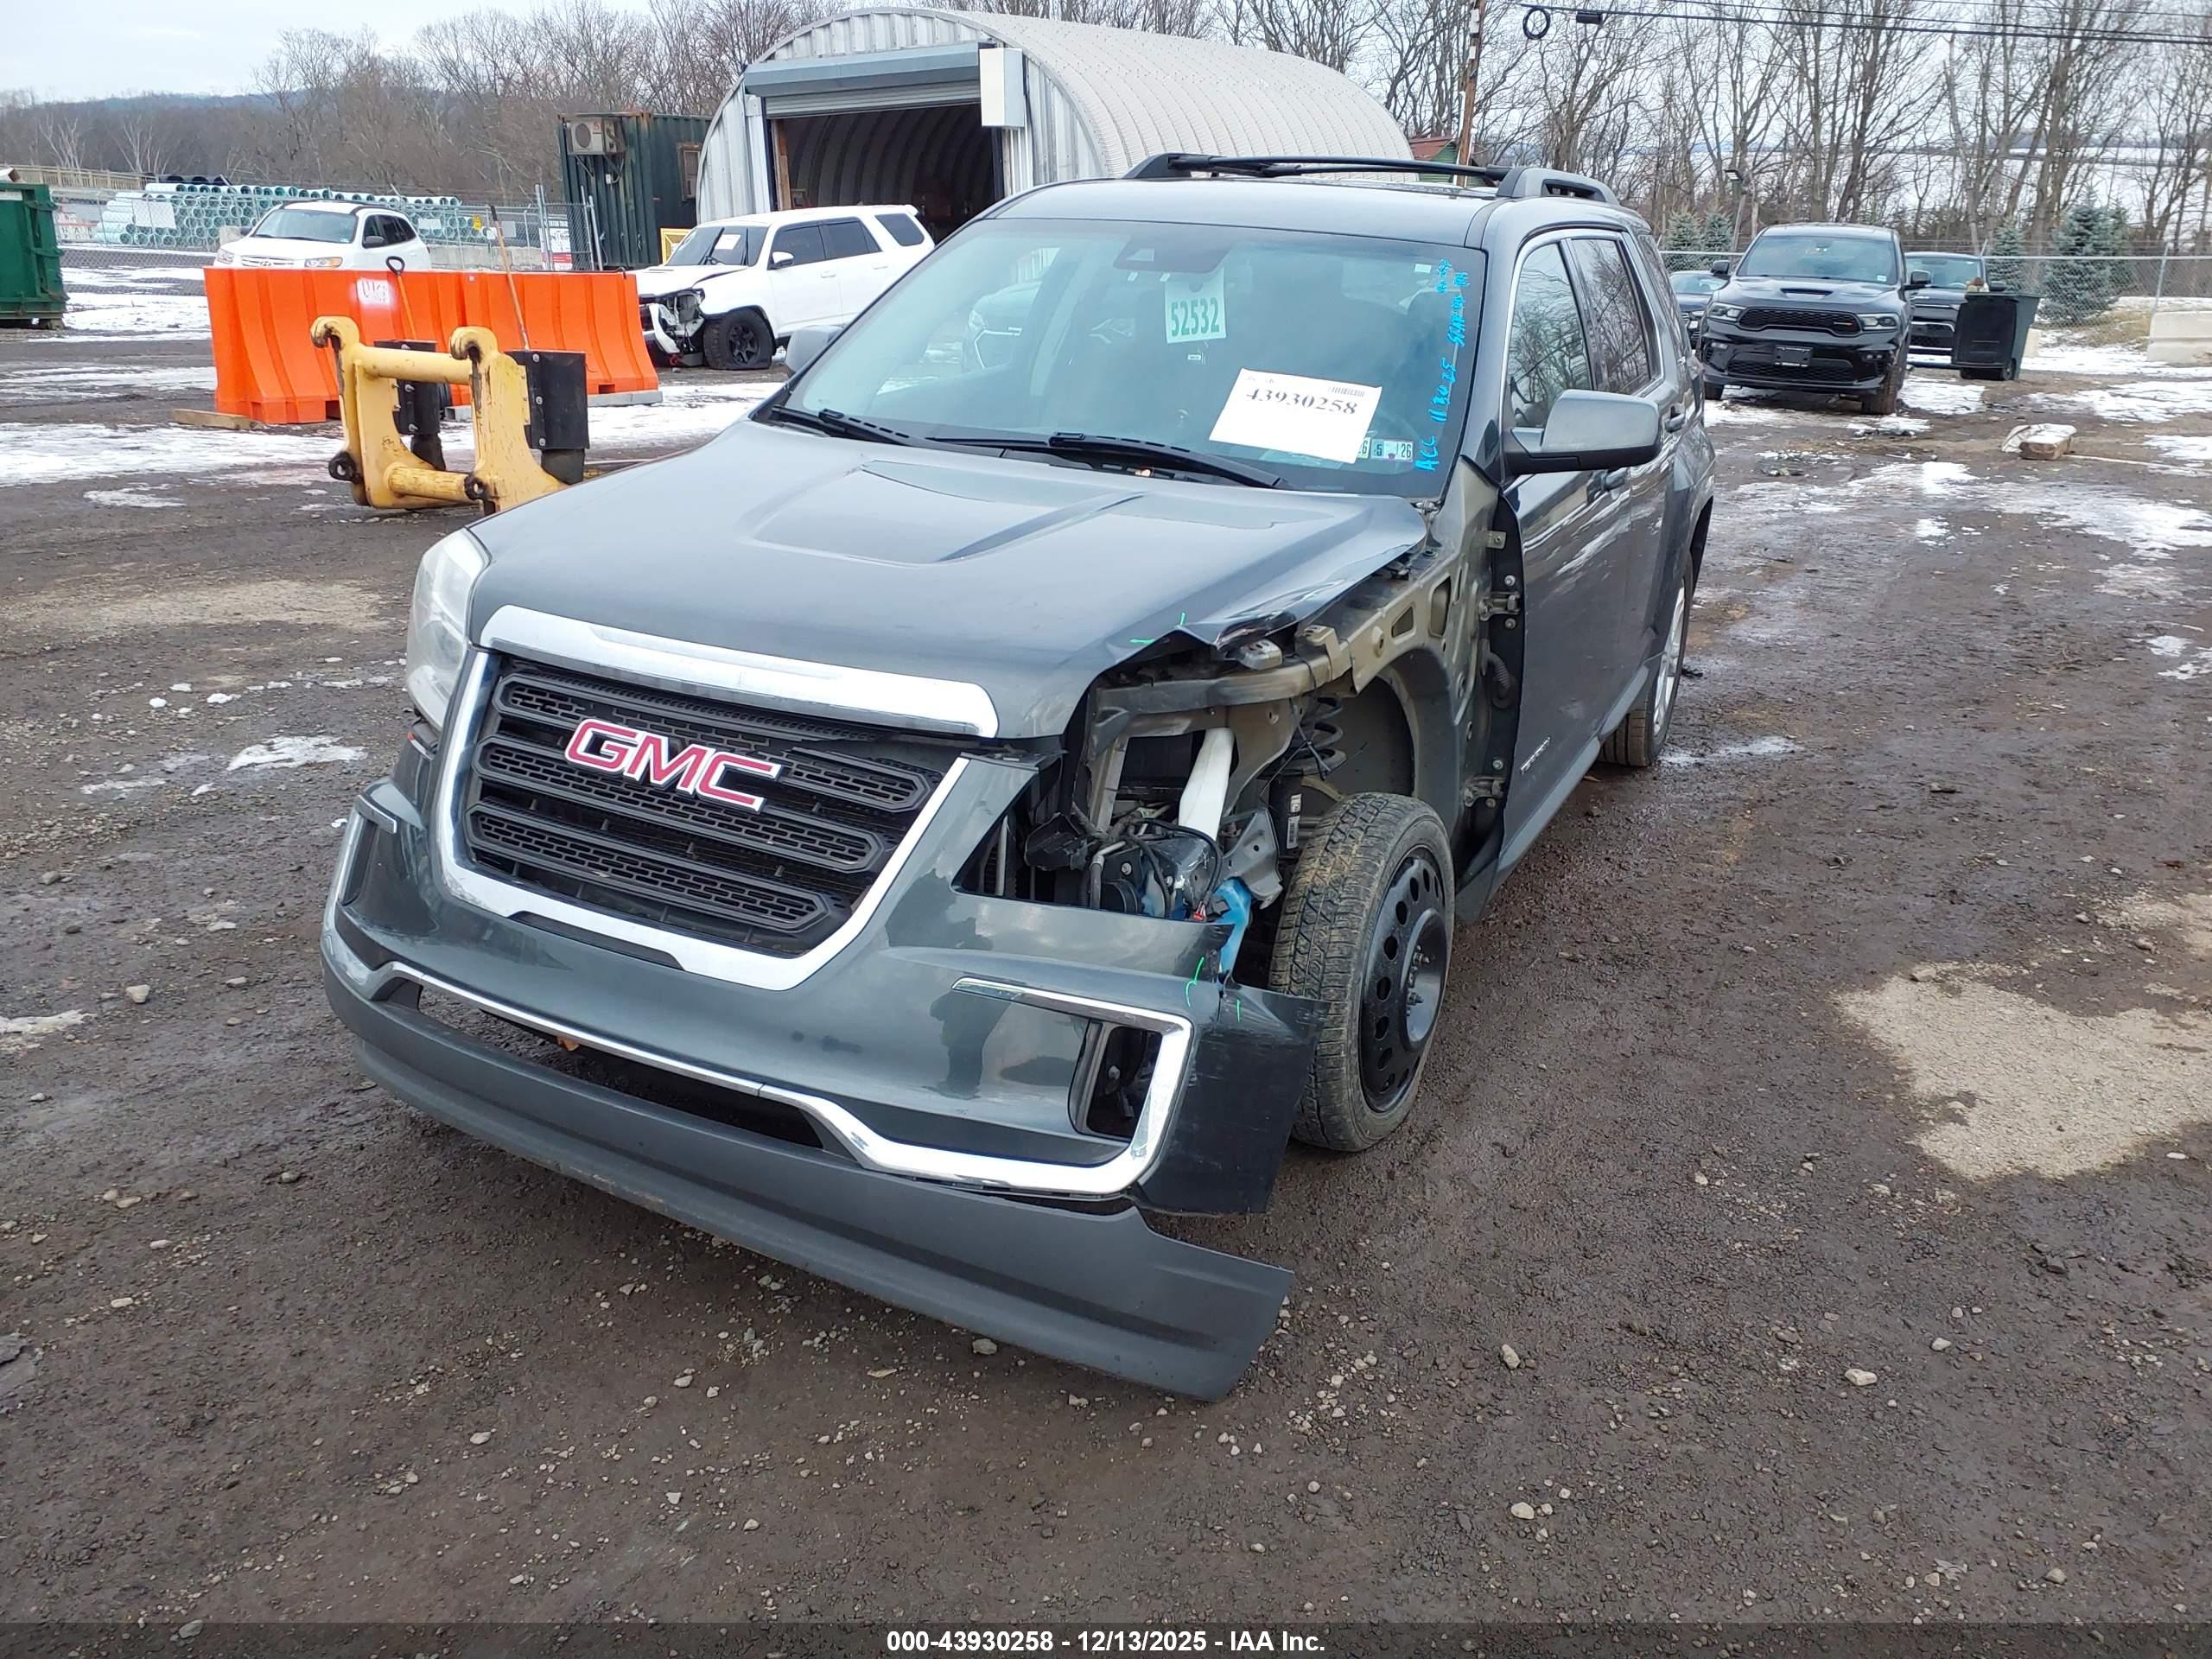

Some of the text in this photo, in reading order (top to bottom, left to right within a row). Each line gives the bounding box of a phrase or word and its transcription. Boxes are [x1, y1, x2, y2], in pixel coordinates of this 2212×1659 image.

[1171, 296, 1220, 337] 52532
[1246, 388, 1357, 415] 43930258
[1401, 442, 1412, 458] 26
[564, 718, 782, 811] GMC
